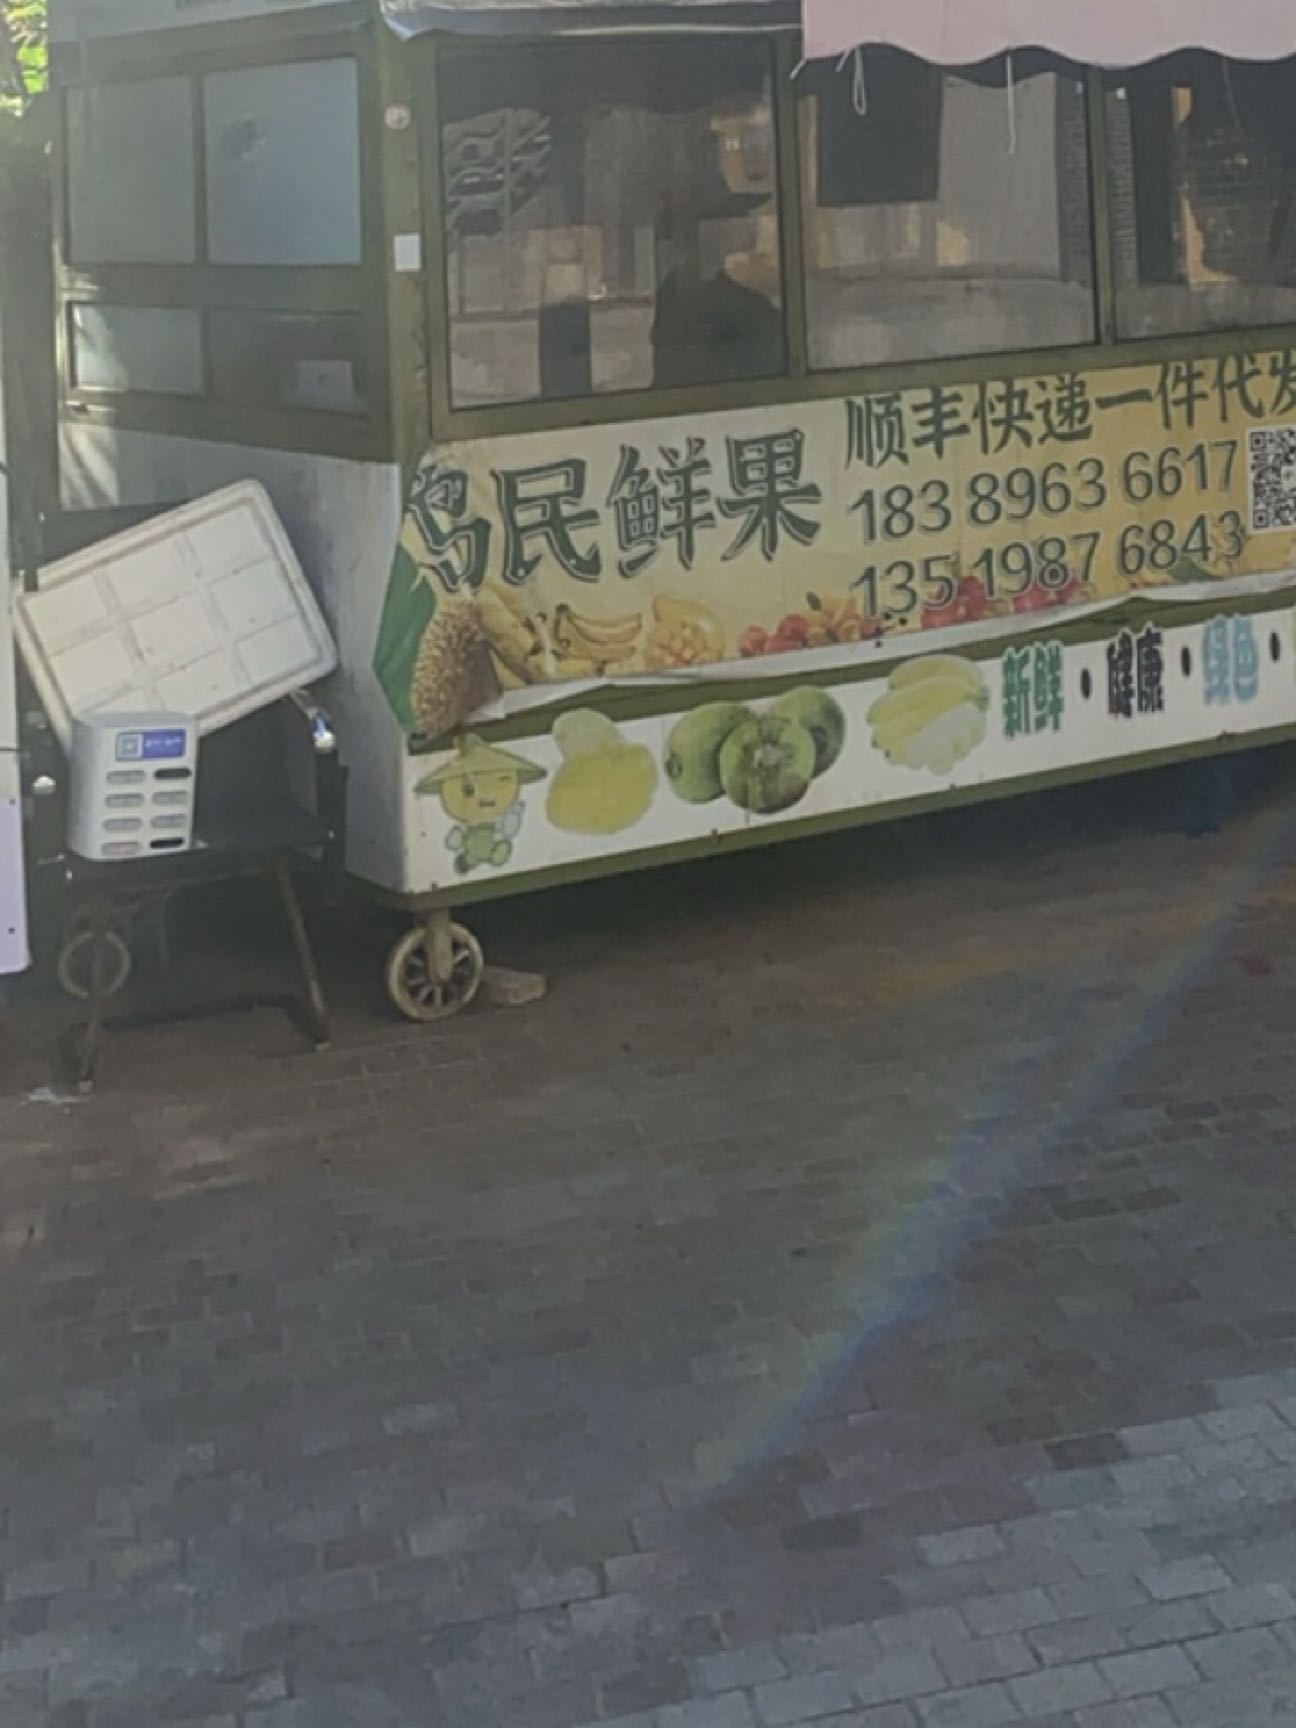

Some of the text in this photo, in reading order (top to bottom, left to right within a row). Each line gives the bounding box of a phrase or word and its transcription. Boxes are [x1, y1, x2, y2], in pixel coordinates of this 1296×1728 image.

[850, 439, 1239, 544] 183 8963 6617
[851, 510, 1246, 620] 135 1987 6843
